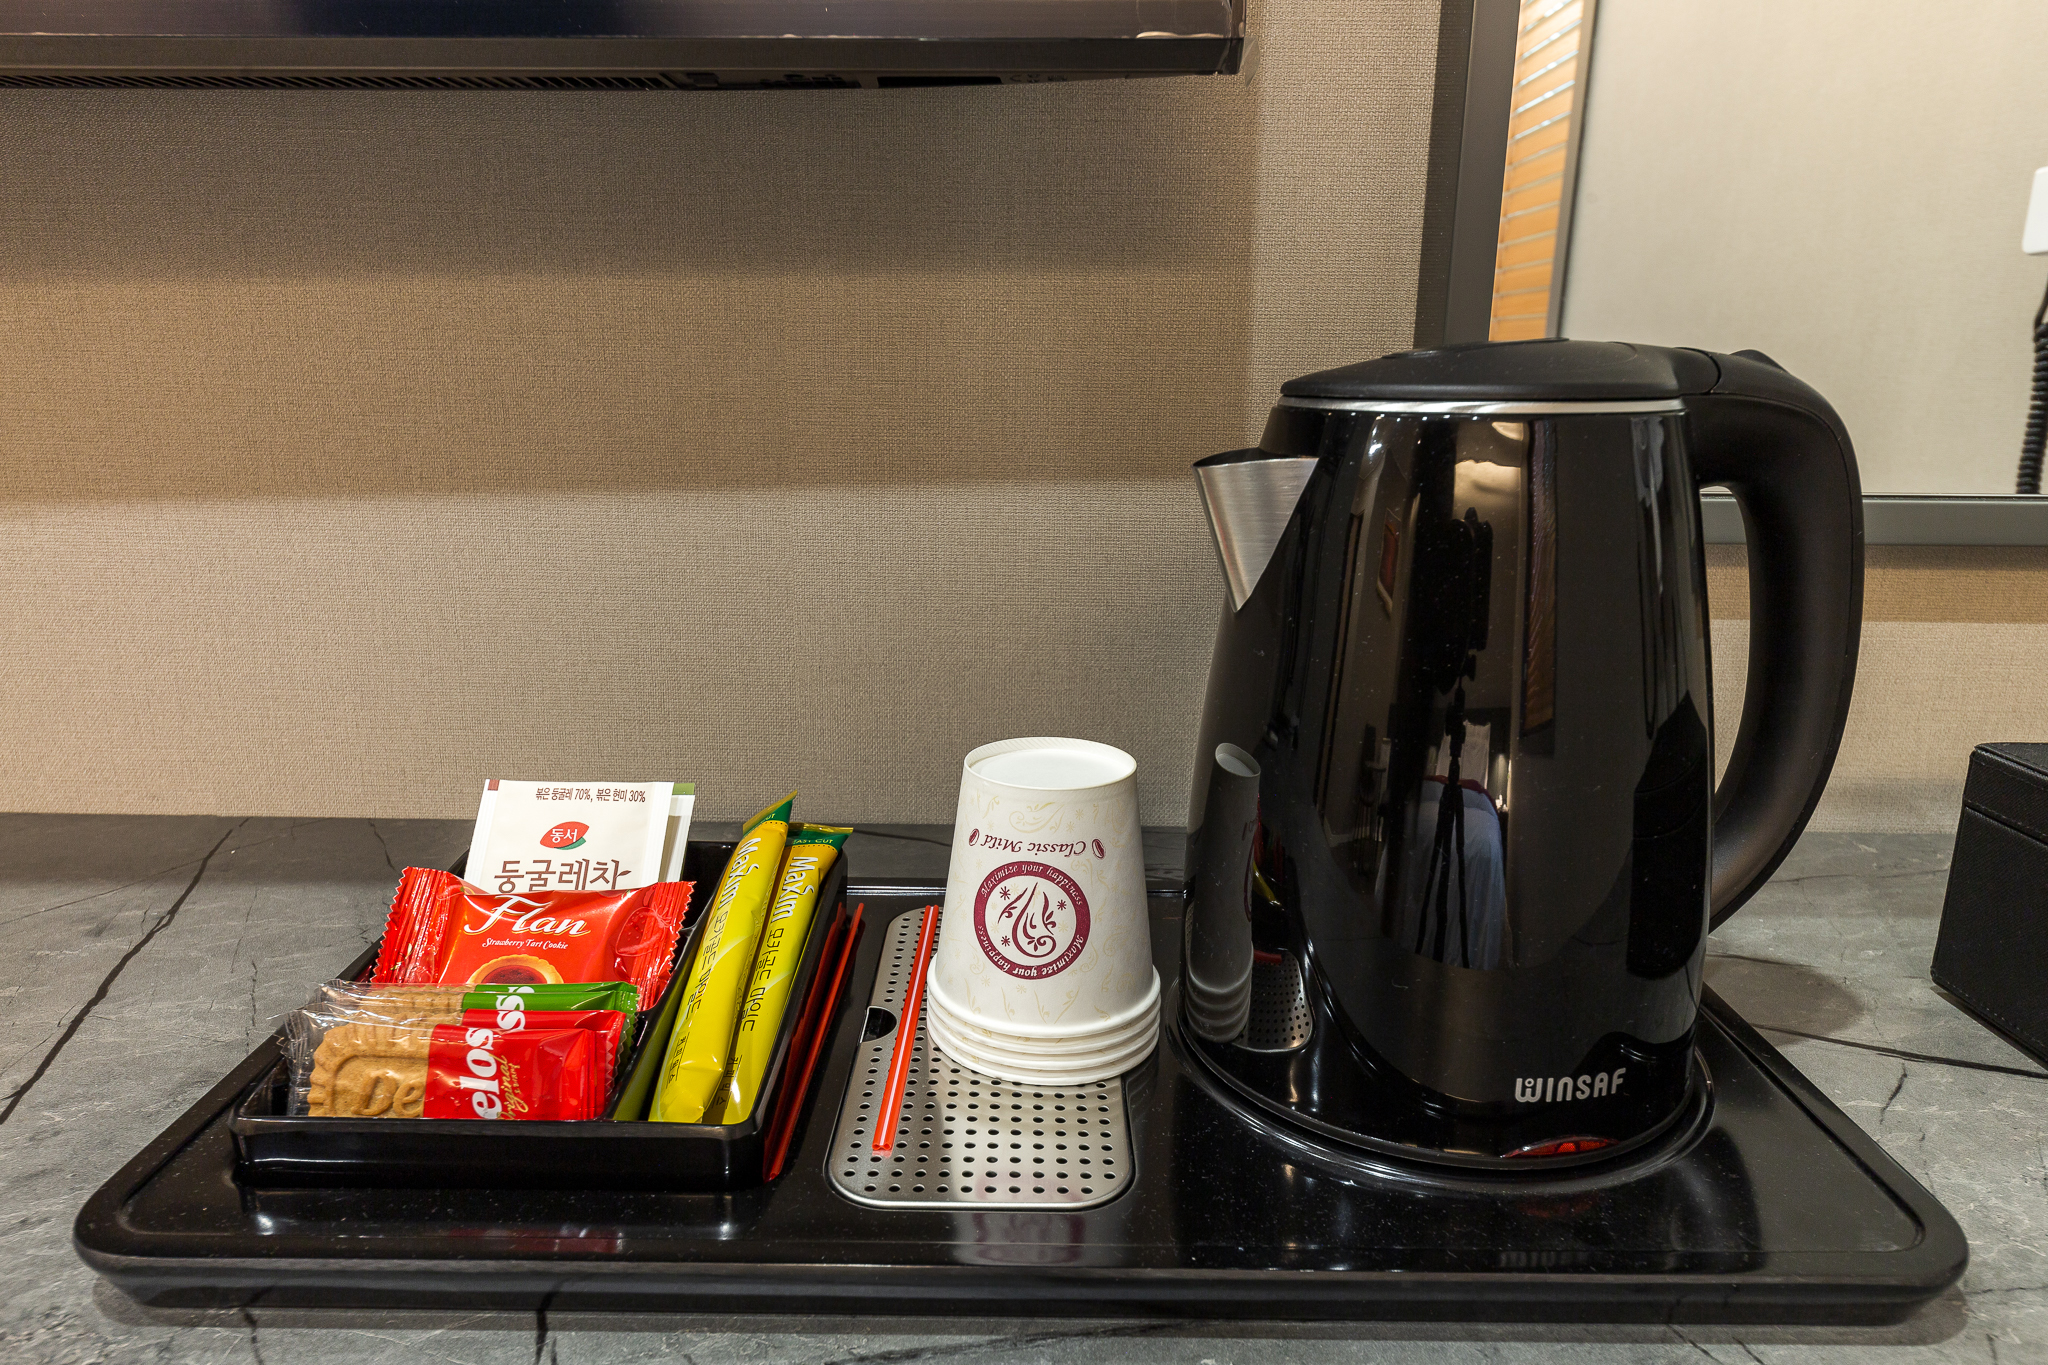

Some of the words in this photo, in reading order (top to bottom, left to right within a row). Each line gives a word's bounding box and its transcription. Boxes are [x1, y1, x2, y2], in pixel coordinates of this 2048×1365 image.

[536, 787, 550, 801] 볶은
[551, 787, 574, 801] 둥굴레
[574, 788, 593, 803] 70%,
[596, 788, 612, 802] 볶은
[613, 788, 627, 802] 현미
[628, 789, 646, 803] 30%
[550, 828, 578, 843] 동서
[980, 834, 1023, 853] Mild
[1027, 840, 1087, 858] Classic
[494, 858, 632, 894] 둥굴레차
[717, 837, 761, 911] Maxim
[771, 856, 818, 924] Maxim
[981, 864, 1019, 898] Maximize
[1021, 864, 1044, 876] your
[1046, 866, 1083, 906] happiness
[463, 894, 591, 937] Flan
[482, 937, 525, 949] Strawberry
[526, 938, 543, 948] Tart
[542, 940, 569, 950] Cookie
[702, 910, 728, 971] 모카골드
[754, 927, 784, 986] 모카골드
[978, 924, 1011, 972] happiness
[1041, 934, 1085, 976] Maximize
[1012, 965, 1038, 978] your
[1515, 1067, 1627, 1103] WINSAF
